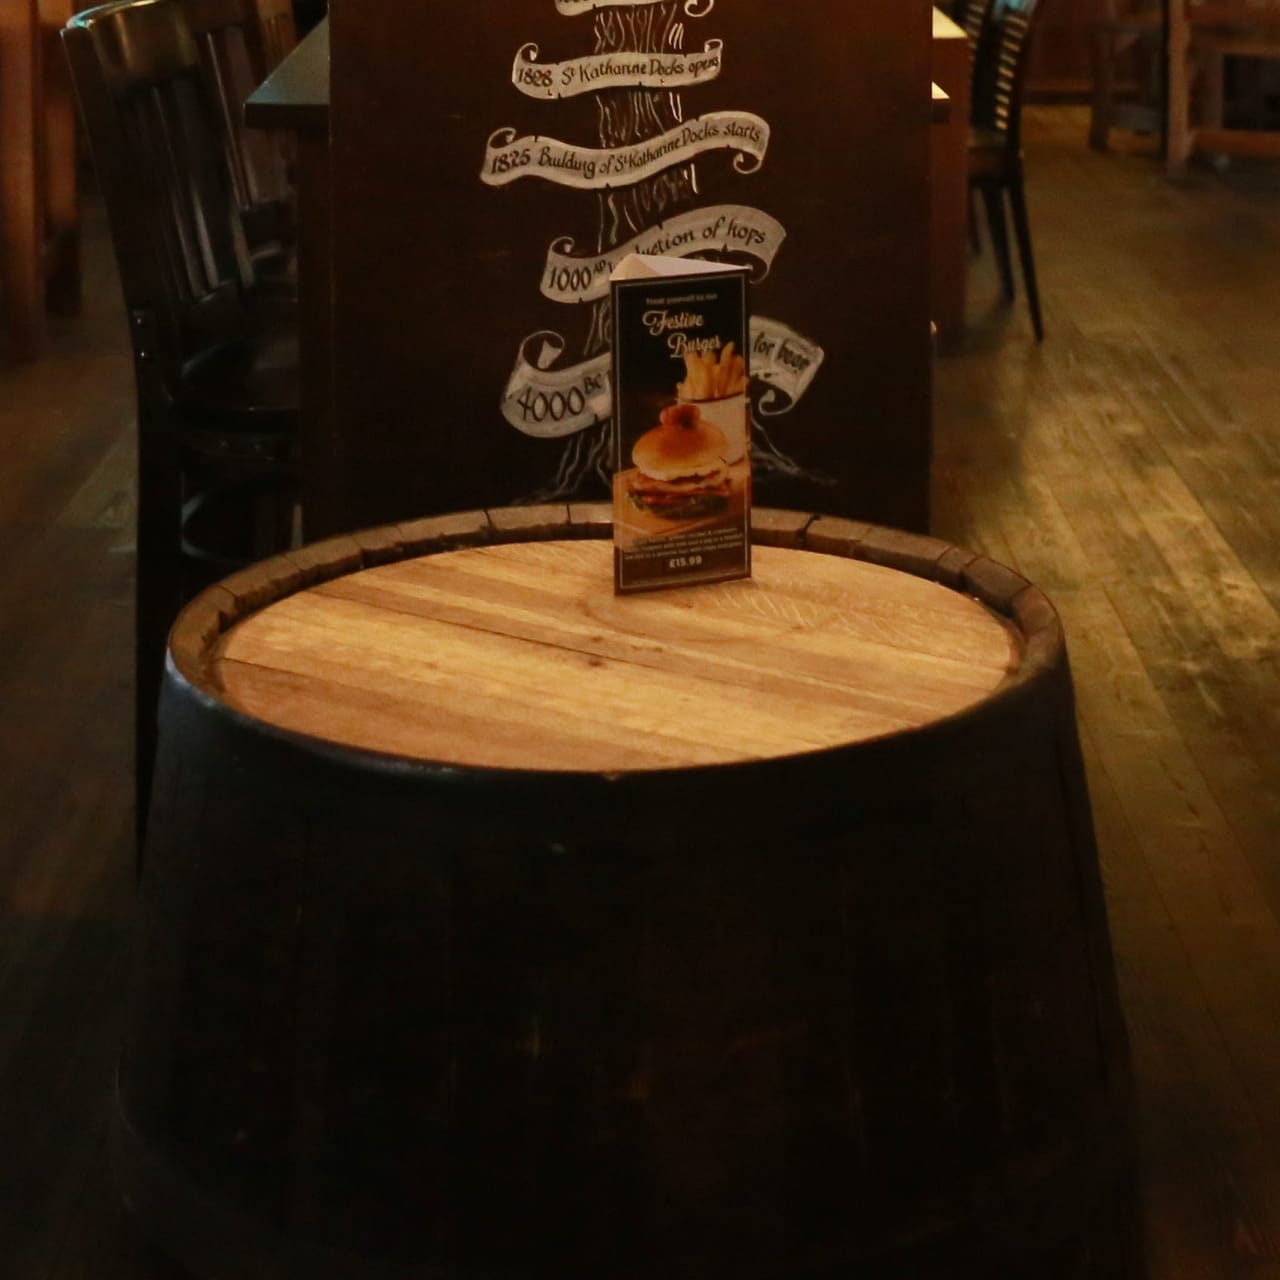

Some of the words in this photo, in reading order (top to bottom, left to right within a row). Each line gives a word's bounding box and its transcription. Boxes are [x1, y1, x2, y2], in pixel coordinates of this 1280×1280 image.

[578, 61, 647, 82] Katharine
[649, 58, 685, 77] Docks
[688, 57, 720, 73] opens
[491, 148, 532, 175] 1825
[537, 146, 596, 179] Building
[599, 160, 614, 175] of
[628, 137, 681, 169] Katharine
[682, 125, 720, 149] Docks
[722, 122, 761, 142] starts
[702, 215, 726, 239] of
[727, 219, 767, 245] hops
[642, 309, 705, 336] Festive
[667, 332, 722, 358] Burger
[753, 331, 775, 355] for
